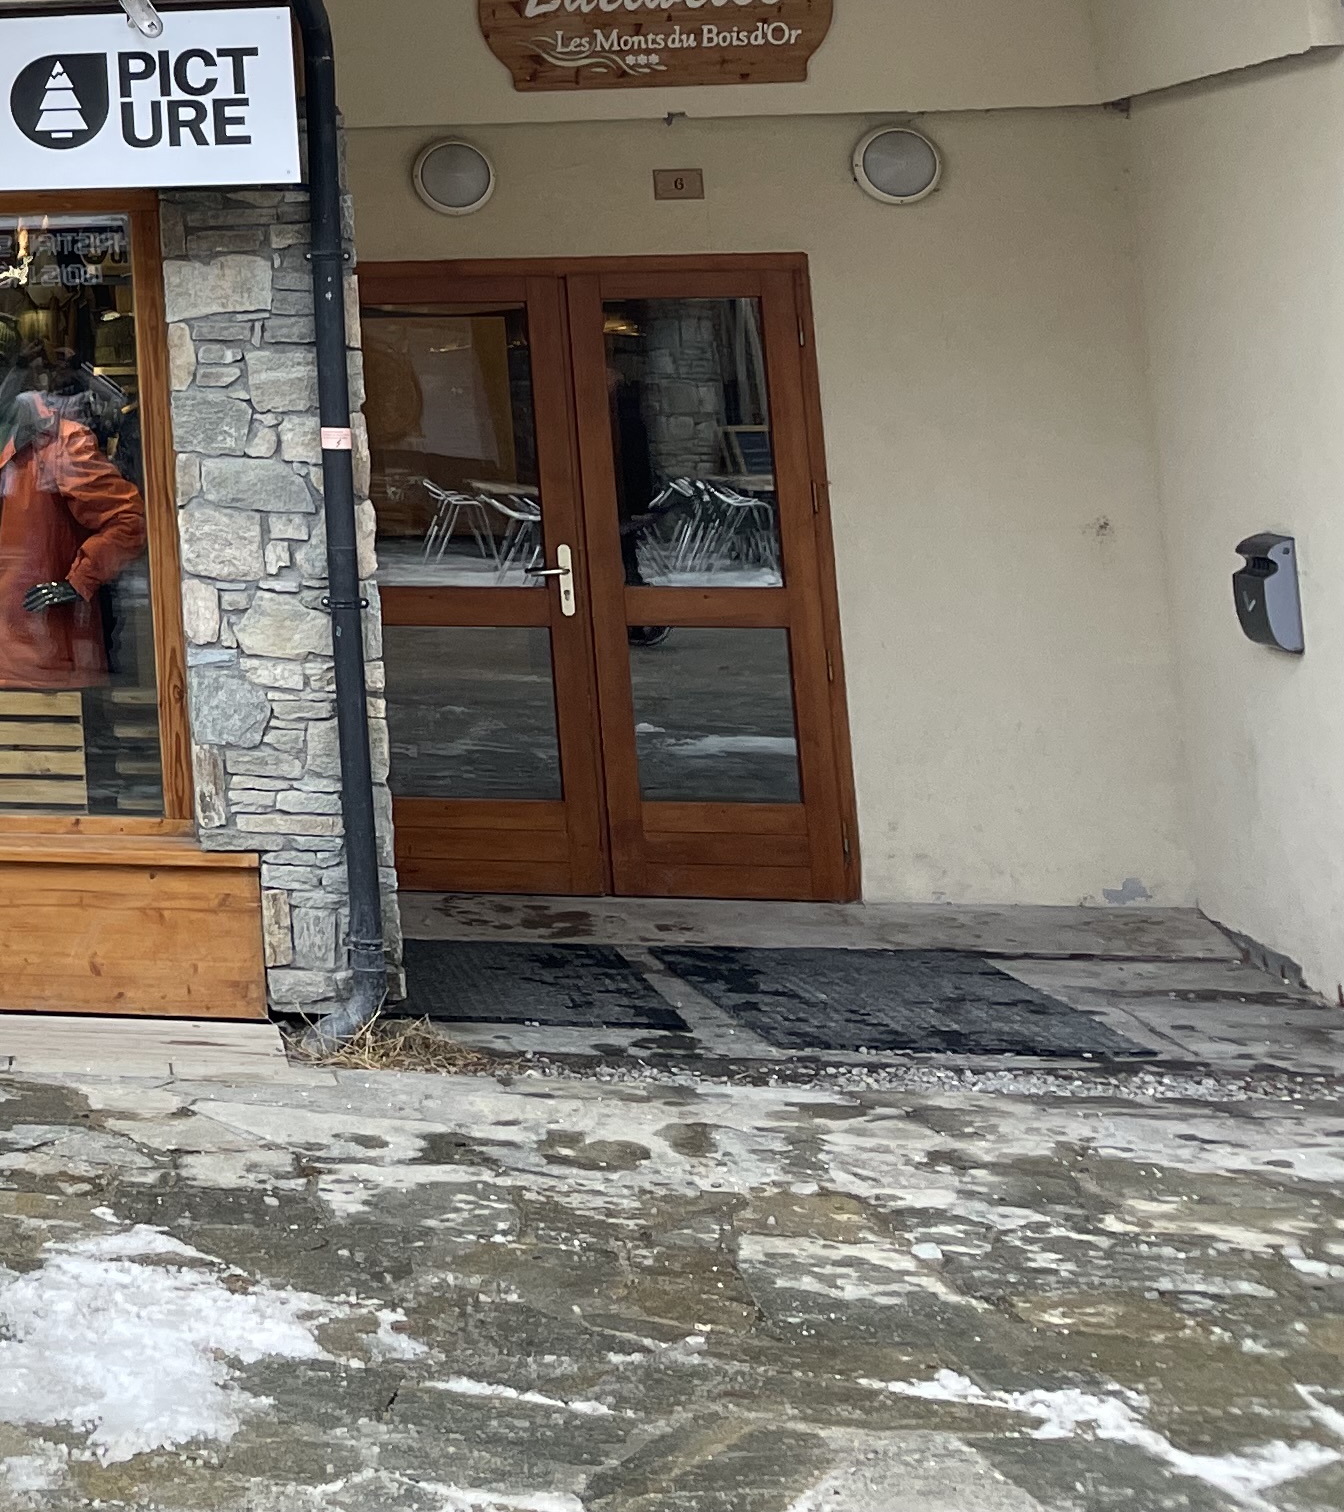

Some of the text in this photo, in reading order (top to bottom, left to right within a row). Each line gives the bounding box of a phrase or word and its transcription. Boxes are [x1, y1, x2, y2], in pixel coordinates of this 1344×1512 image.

[555, 21, 802, 54] Les Monts du Bois d'Or
[117, 46, 259, 99] PICT
[119, 98, 252, 149] URE
